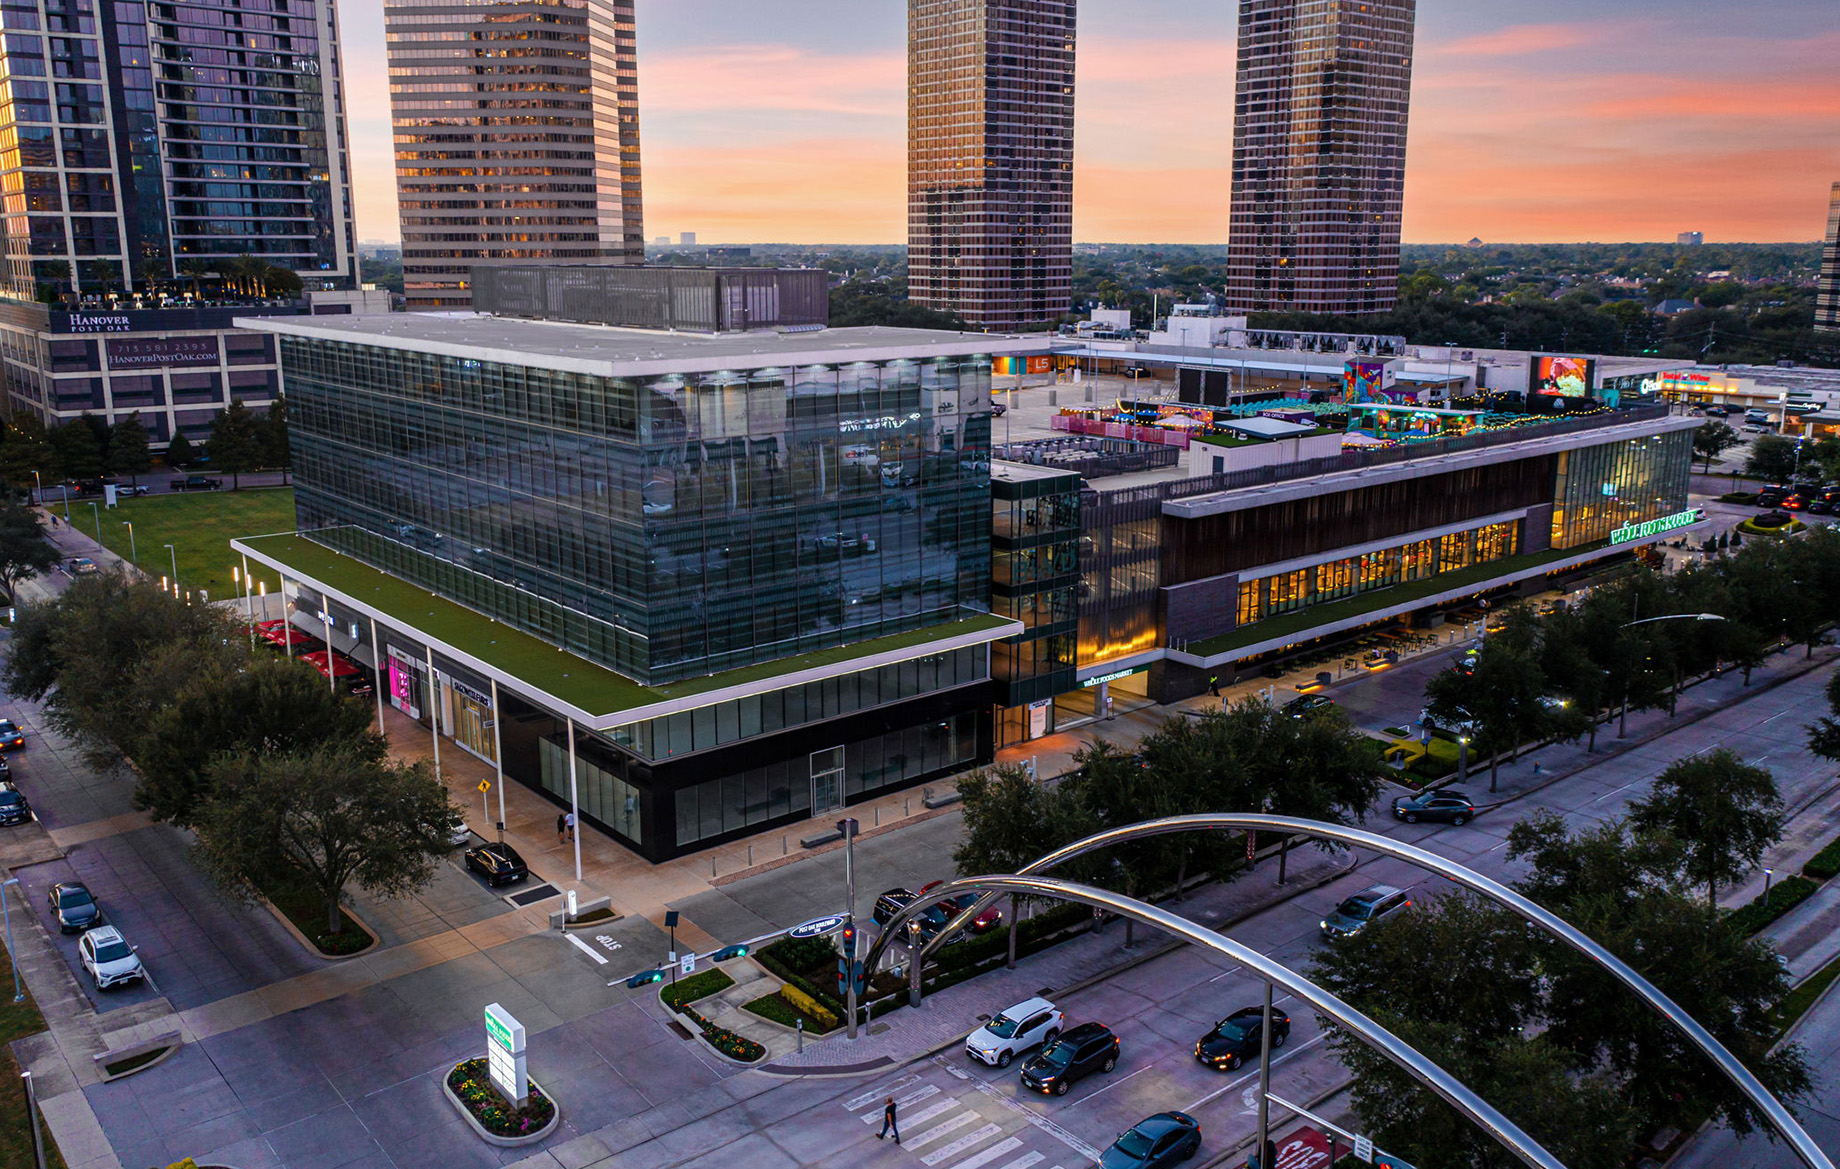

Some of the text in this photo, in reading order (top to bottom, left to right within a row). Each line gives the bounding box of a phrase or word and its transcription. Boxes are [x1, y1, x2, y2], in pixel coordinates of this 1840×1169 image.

[69, 314, 130, 325] HANOVER
[146, 344, 168, 352] 581
[175, 343, 207, 351] 2393
[1035, 358, 1049, 368] L5
[1662, 371, 1711, 381] Total Wine
[595, 935, 623, 951] STOP
